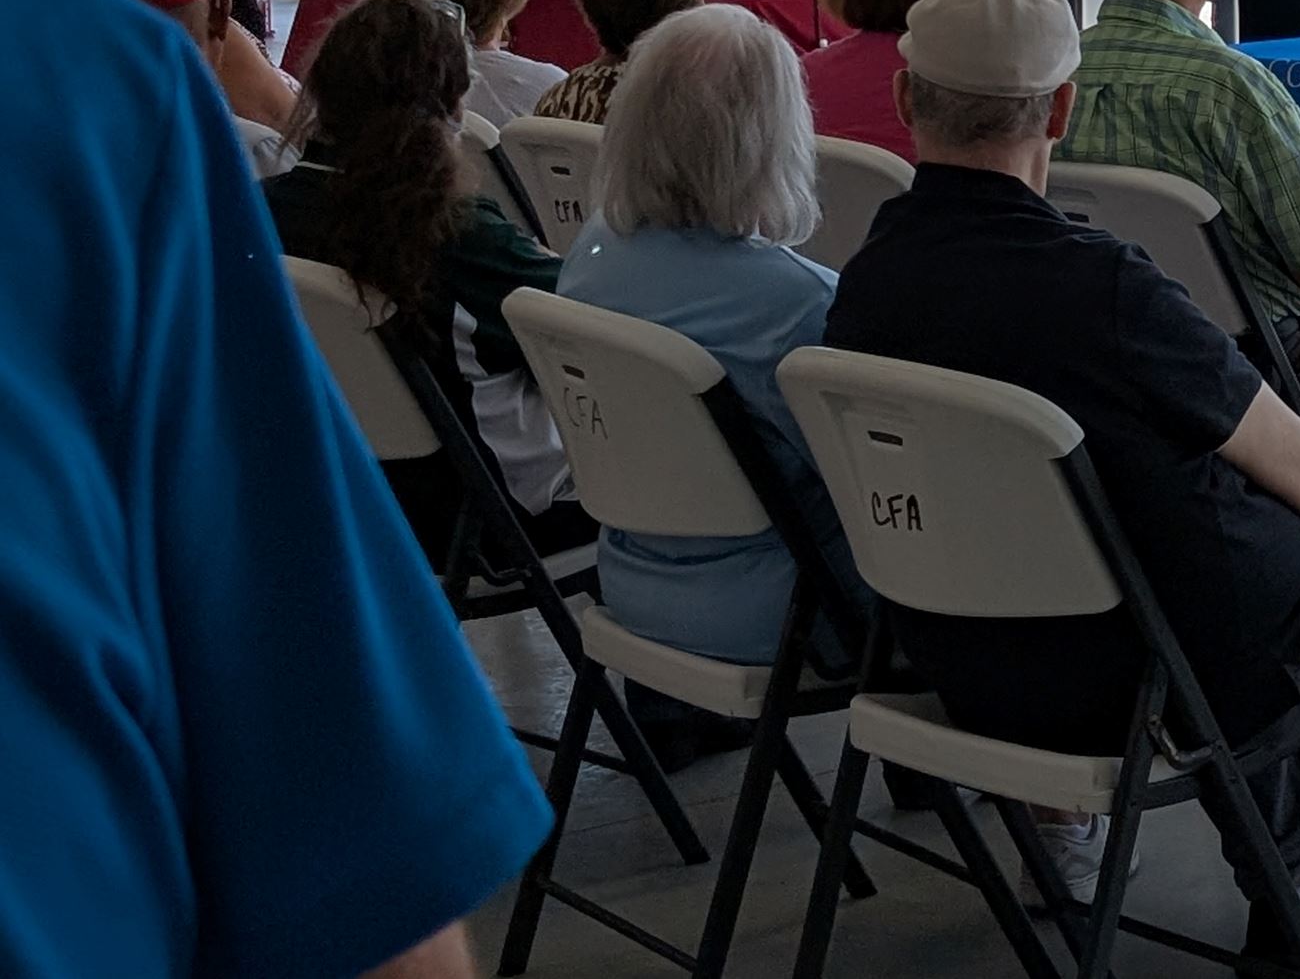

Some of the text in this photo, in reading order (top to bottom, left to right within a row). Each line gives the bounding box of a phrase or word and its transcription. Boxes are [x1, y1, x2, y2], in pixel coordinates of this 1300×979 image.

[554, 199, 584, 223] CFA
[563, 387, 609, 439] CFA
[871, 491, 923, 531] CFA
